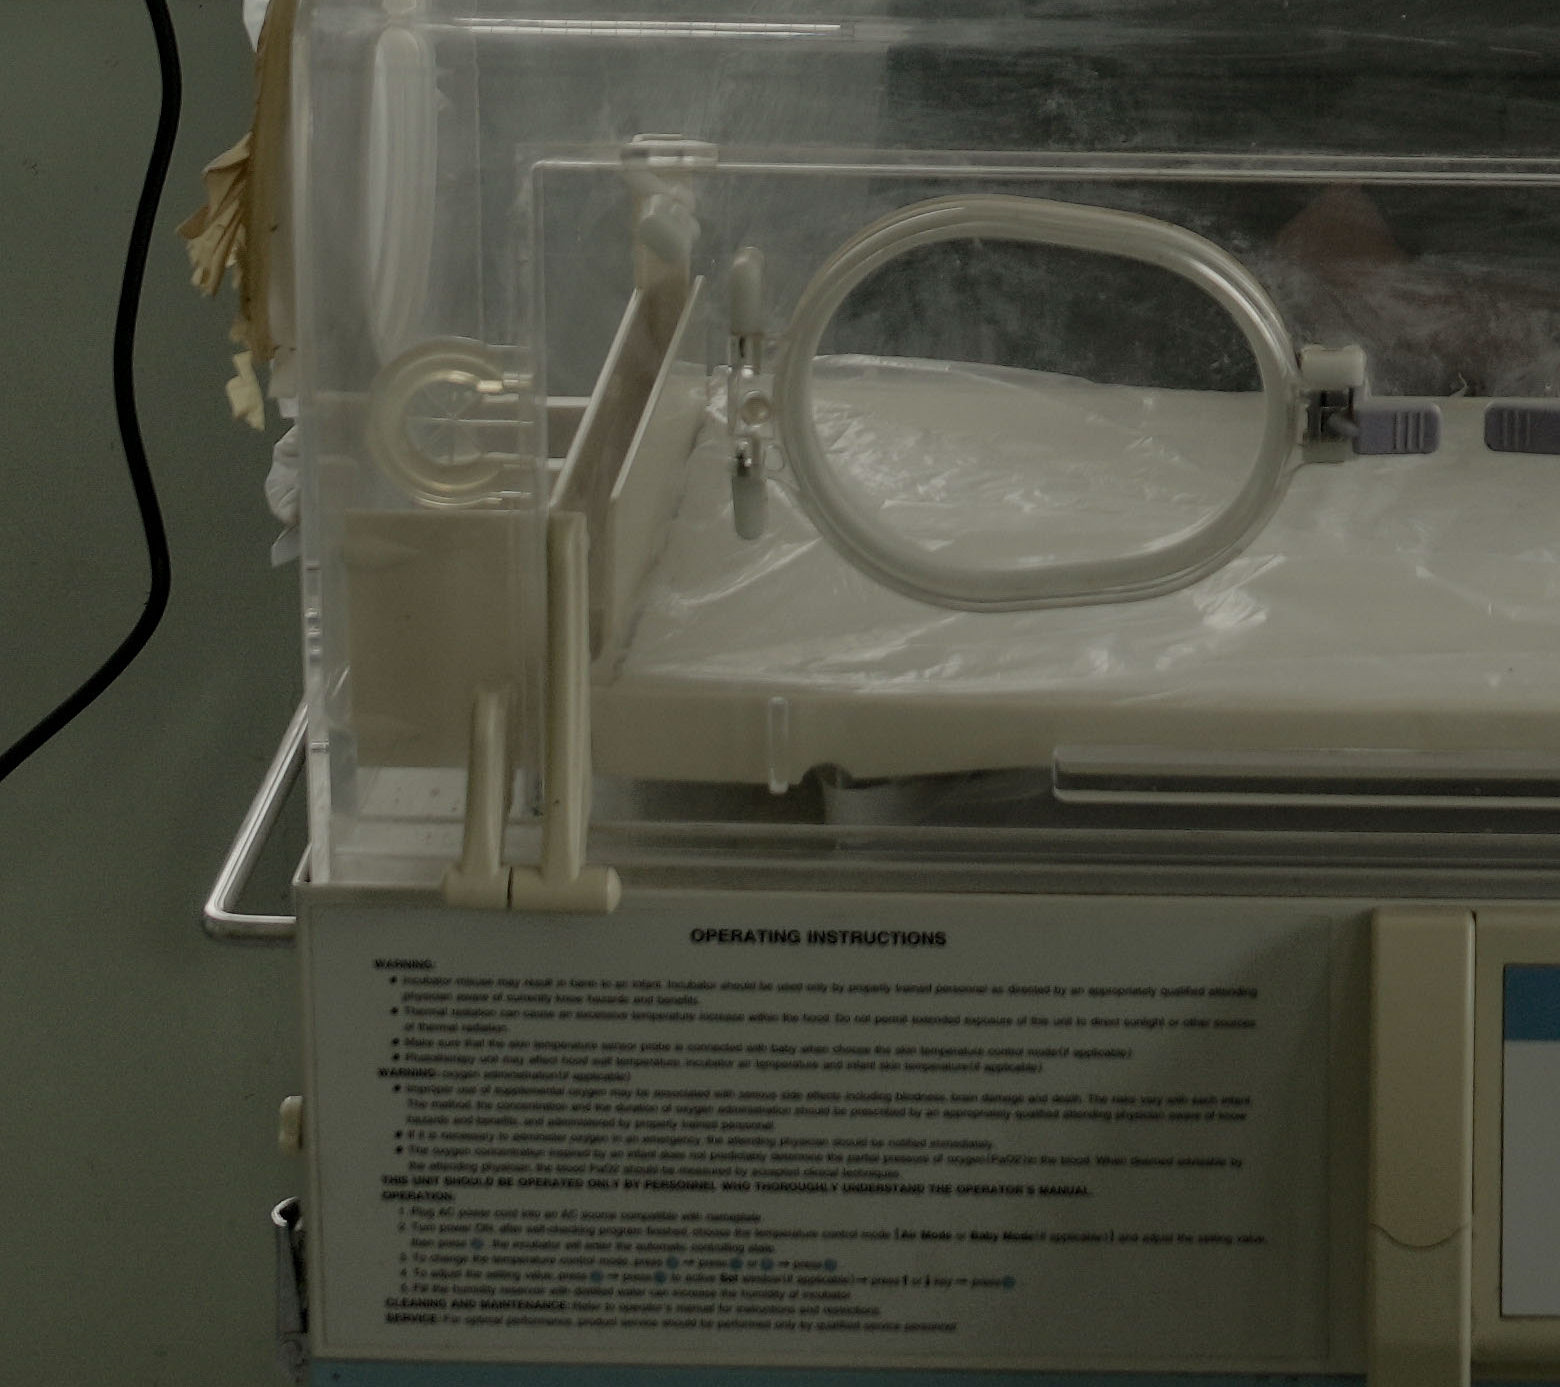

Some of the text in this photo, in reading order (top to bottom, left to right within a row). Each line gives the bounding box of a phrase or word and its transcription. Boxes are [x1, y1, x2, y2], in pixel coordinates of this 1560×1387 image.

[690, 927, 947, 946] OPERATING INSTRUCTIONS
[382, 1175, 410, 1187] THIS
[411, 1175, 441, 1187] UNIT
[442, 1176, 496, 1188] SHOULD
[497, 1177, 514, 1189] BE
[515, 1177, 585, 1189] OPERATED
[586, 1178, 621, 1190] ONLY
[622, 1179, 640, 1191] BY
[641, 1179, 718, 1191] PERSONNEL
[719, 1180, 752, 1192] WHO
[753, 1181, 839, 1193] THOROUGHLY
[840, 1182, 925, 1194] UNDERSTAND
[926, 1183, 953, 1195] THE
